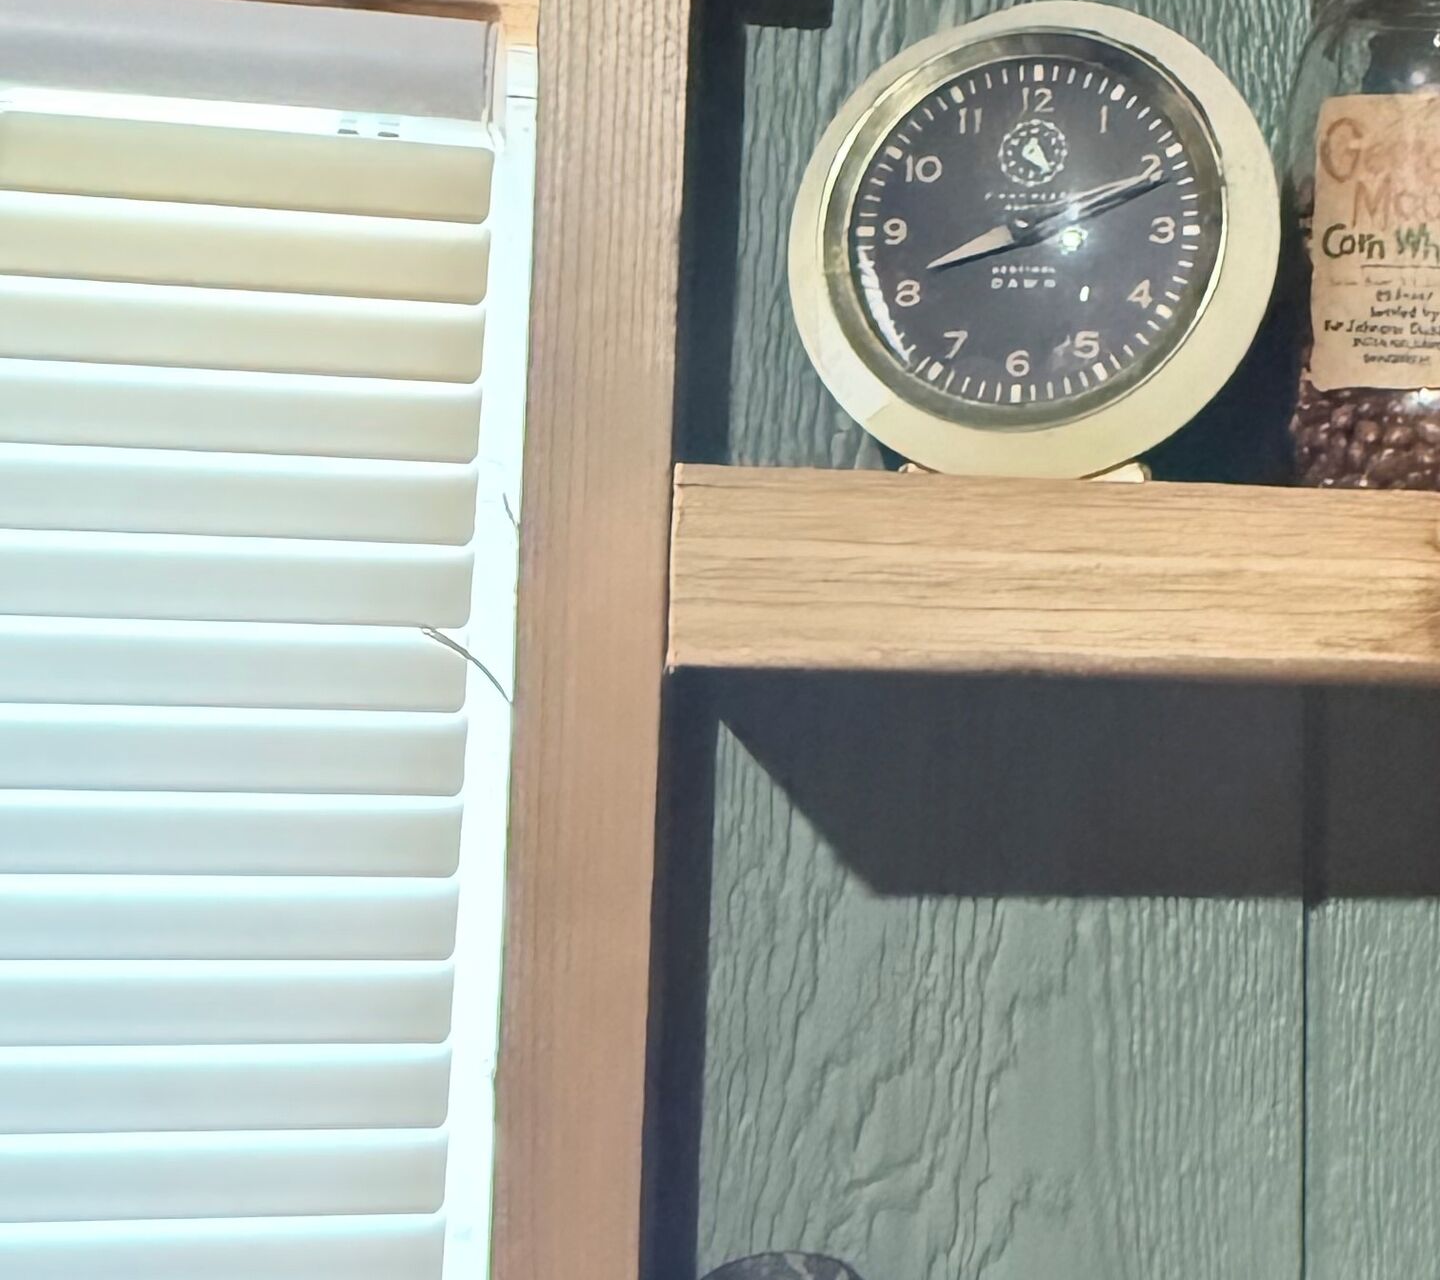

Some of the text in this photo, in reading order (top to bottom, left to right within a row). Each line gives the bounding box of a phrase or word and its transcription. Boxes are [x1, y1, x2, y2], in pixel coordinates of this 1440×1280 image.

[1022, 86, 1055, 114] 12
[958, 107, 982, 135] 11
[1099, 105, 1108, 134] 1
[905, 154, 943, 183] 10
[1140, 153, 1164, 181] 2
[882, 218, 908, 245] 9
[1148, 216, 1176, 244] 3
[1322, 223, 1385, 260] Corn
[895, 279, 921, 307] 8
[1127, 278, 1153, 309] 4
[943, 330, 968, 359] 7
[1072, 330, 1101, 358] 5
[1005, 349, 1031, 378] 6
